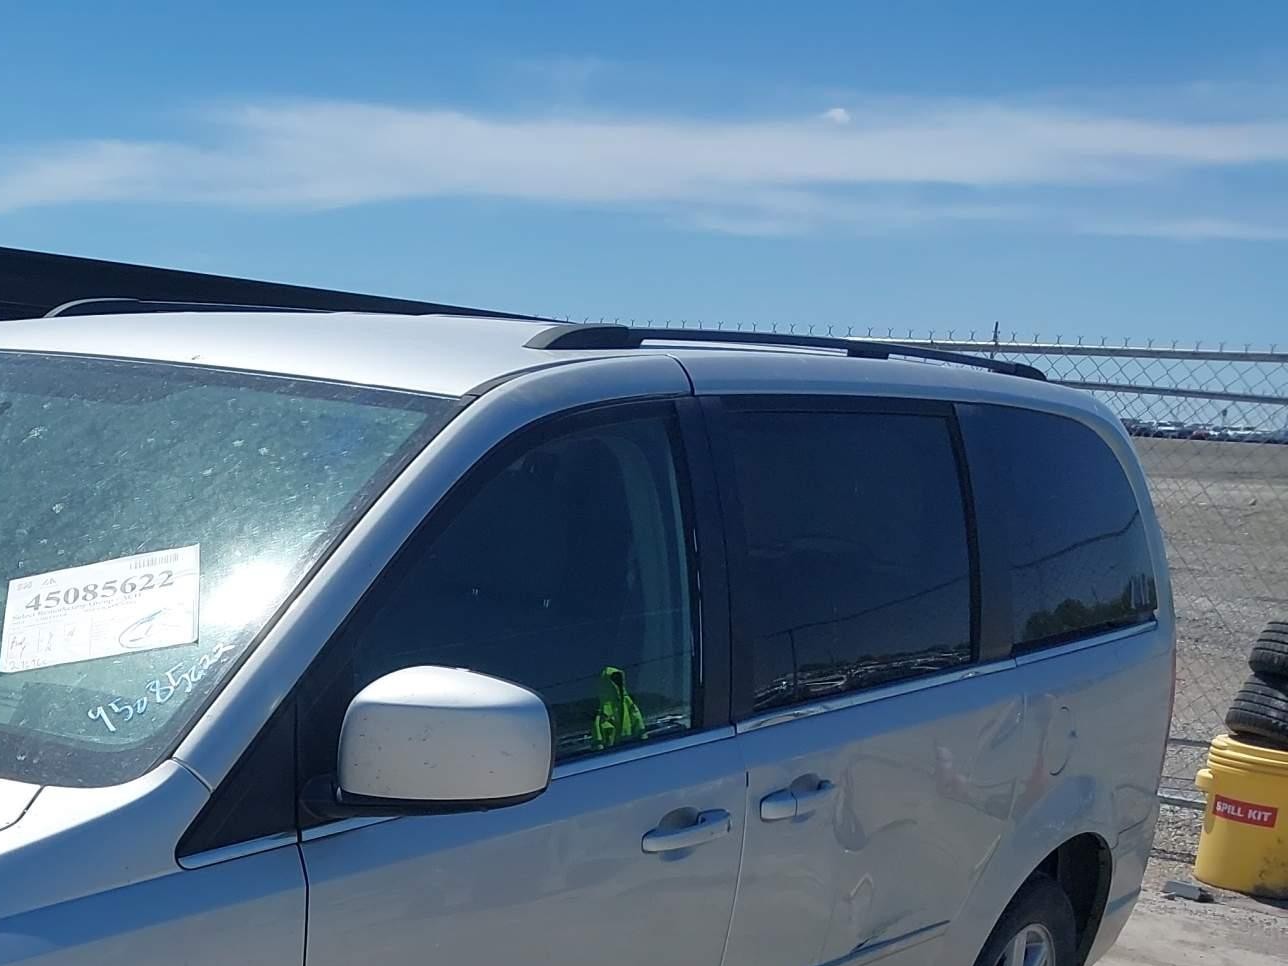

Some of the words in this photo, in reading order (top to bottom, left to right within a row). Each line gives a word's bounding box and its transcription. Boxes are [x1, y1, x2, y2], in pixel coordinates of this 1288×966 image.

[25, 570, 175, 611] 45085622
[1216, 800, 1244, 817] SPILL
[1248, 809, 1273, 822] KIT
